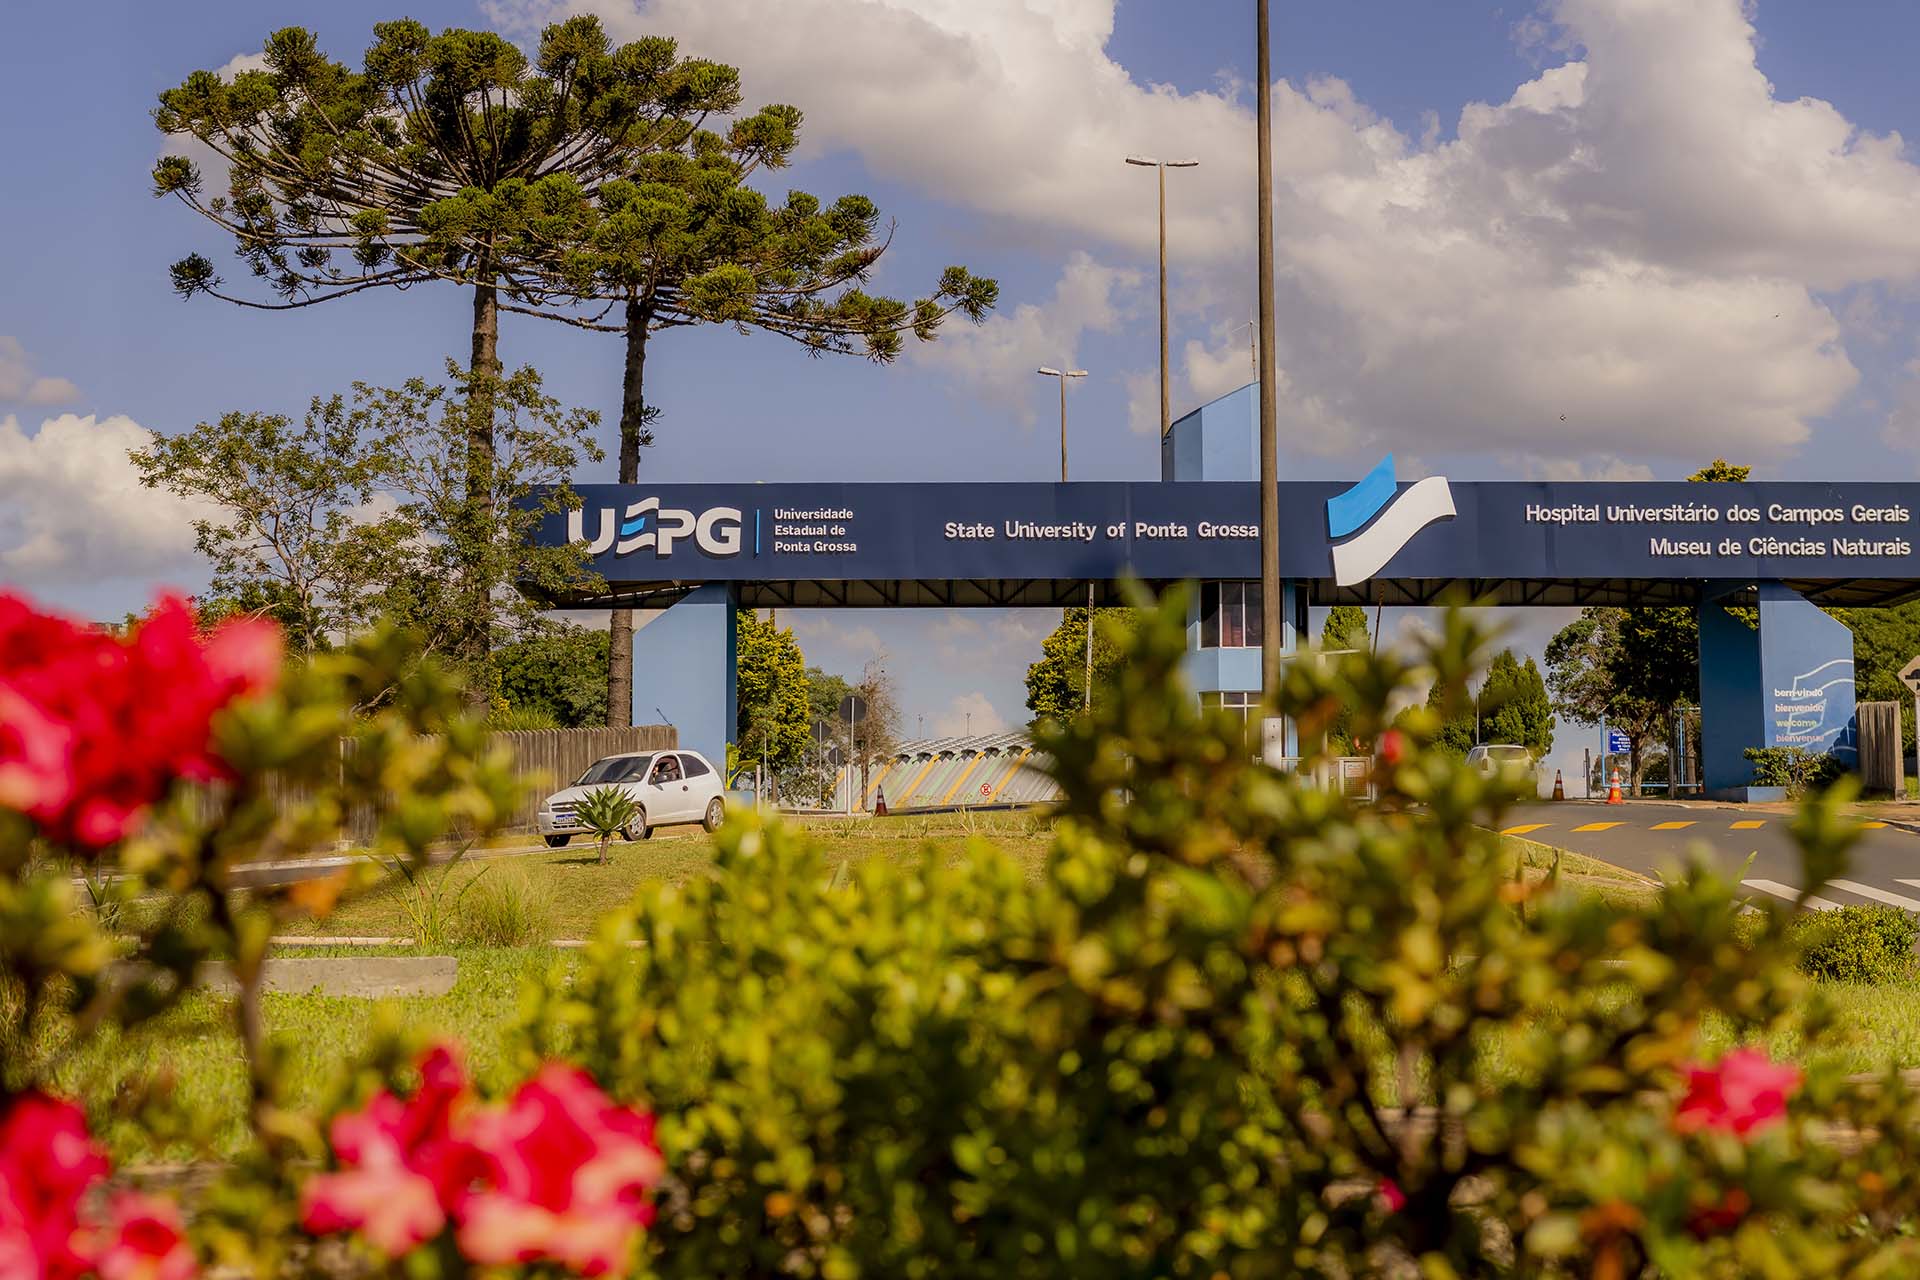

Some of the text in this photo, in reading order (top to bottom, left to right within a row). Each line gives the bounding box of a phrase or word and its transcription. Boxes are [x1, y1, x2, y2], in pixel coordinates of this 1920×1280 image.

[774, 508, 853, 520] Universidade
[1526, 501, 1910, 526] Hospital Universitário dos Campos Gerais
[774, 525, 846, 537] Estadual de
[944, 520, 1259, 541] State University of Ponta Grossa
[774, 541, 857, 553] Ponta Grossa
[1650, 537, 1912, 556] Museu de Ciências Naturais
[1775, 703, 1824, 713] bienvenido
[1776, 719, 1817, 728] welcome
[1776, 734, 1824, 743] bienvenue
